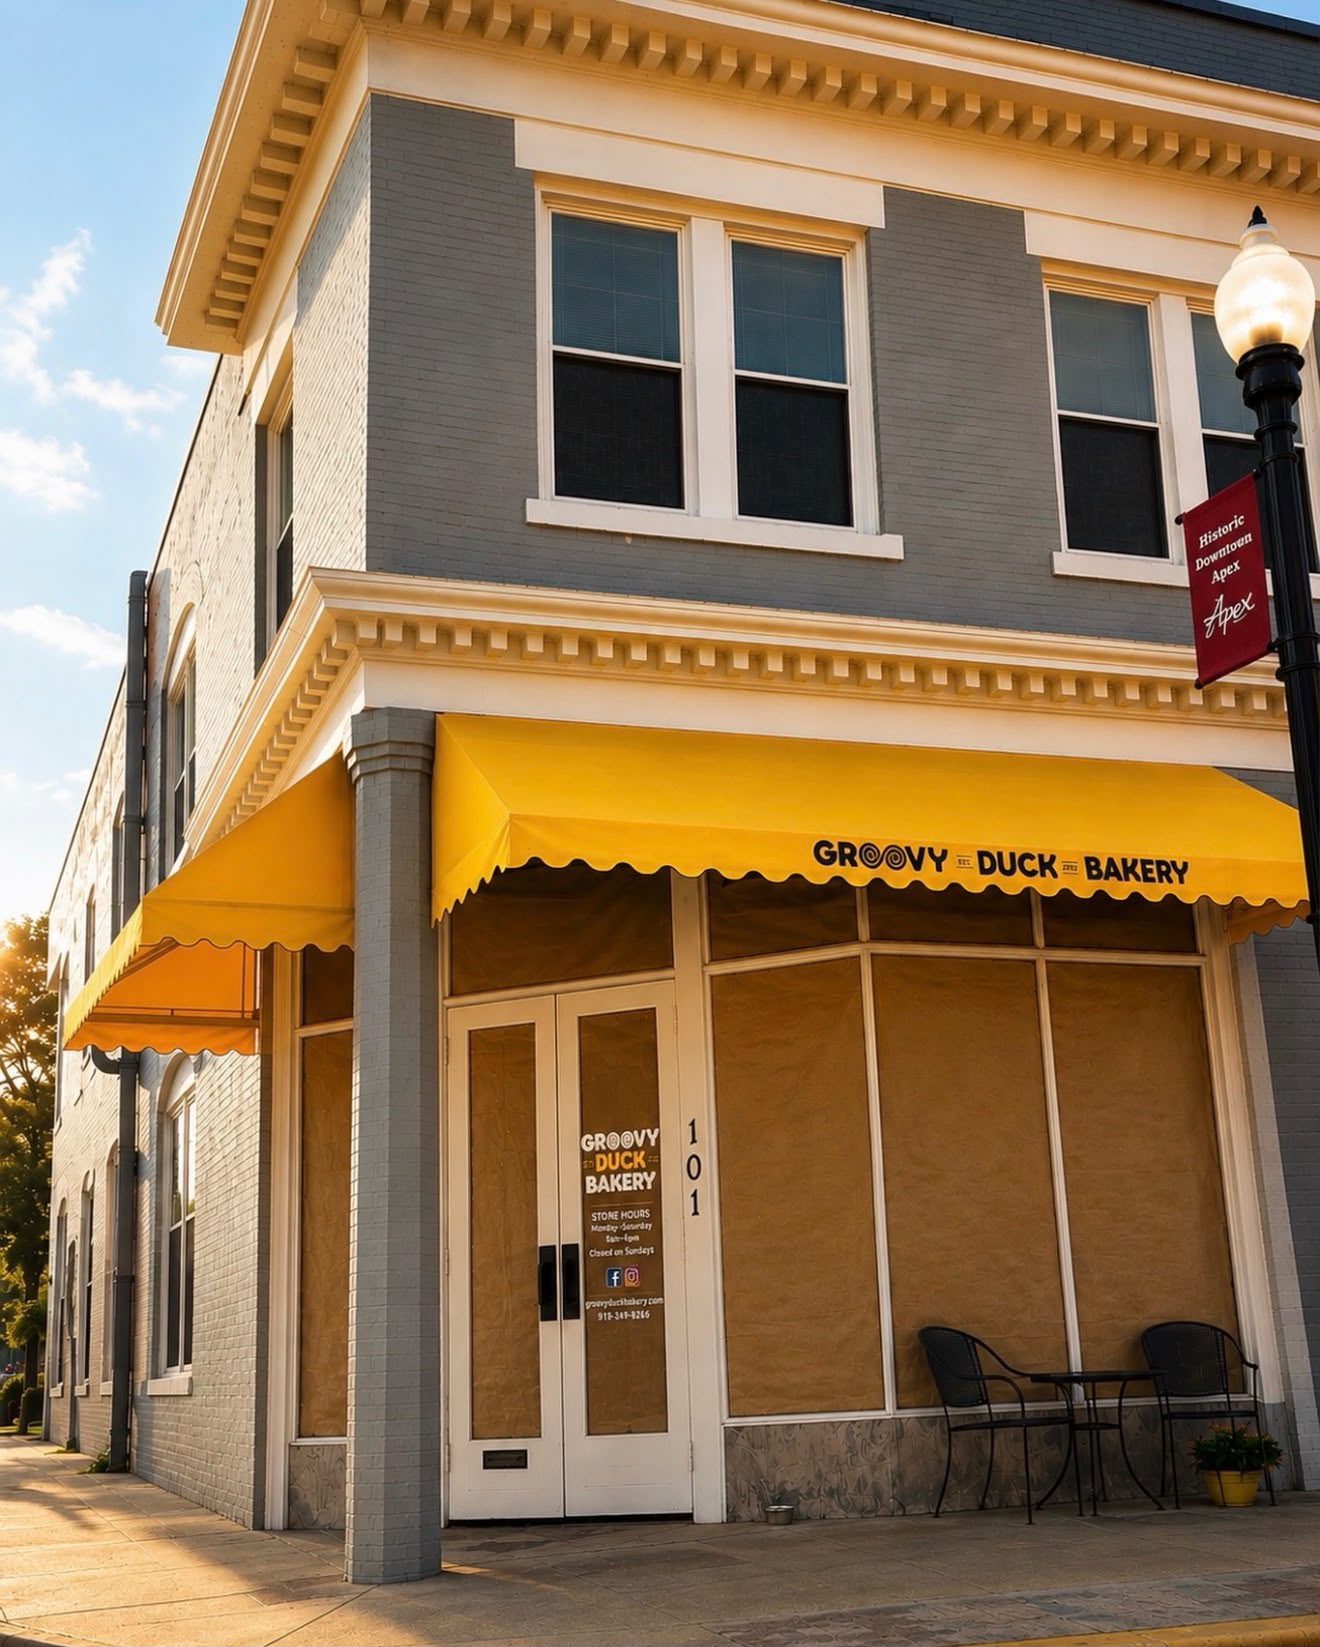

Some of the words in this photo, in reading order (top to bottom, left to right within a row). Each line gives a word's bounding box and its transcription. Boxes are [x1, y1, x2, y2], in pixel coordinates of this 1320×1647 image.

[1199, 514, 1245, 550] Historic
[1195, 532, 1253, 572] Downtown
[1211, 559, 1241, 584] Apex
[1203, 592, 1256, 639] Apex
[813, 839, 949, 873] GROOVY
[976, 850, 1059, 879] DUCK
[1084, 856, 1189, 884] BAKERY
[581, 1127, 660, 1152] GROOVY
[595, 1150, 647, 1172] DUCK
[585, 1171, 657, 1194] BAKERY
[591, 1211, 619, 1221] STORE
[621, 1209, 651, 1219] HOURS
[589, 1247, 613, 1257] Closed
[624, 1246, 655, 1256] Sundays
